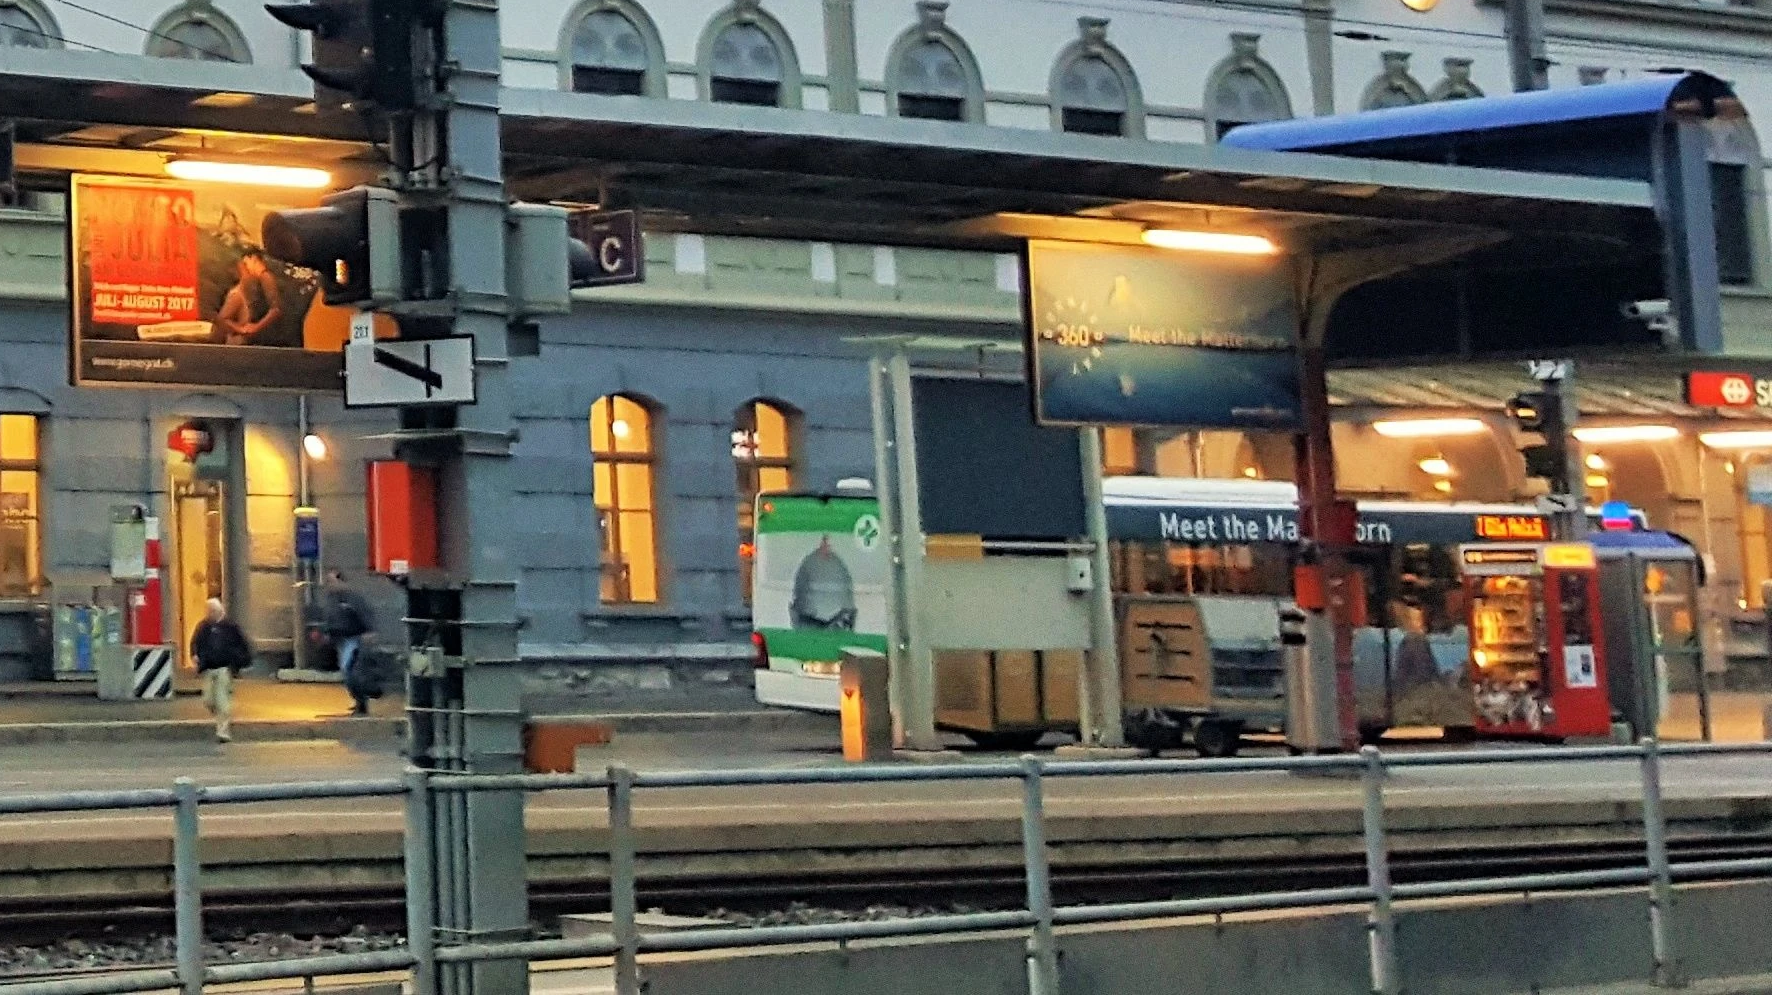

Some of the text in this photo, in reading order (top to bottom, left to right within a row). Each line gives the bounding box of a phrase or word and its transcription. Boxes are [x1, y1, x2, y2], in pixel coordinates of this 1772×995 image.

[599, 235, 621, 273] C
[1159, 512, 1218, 540] Meet
[1224, 513, 1259, 540] the
